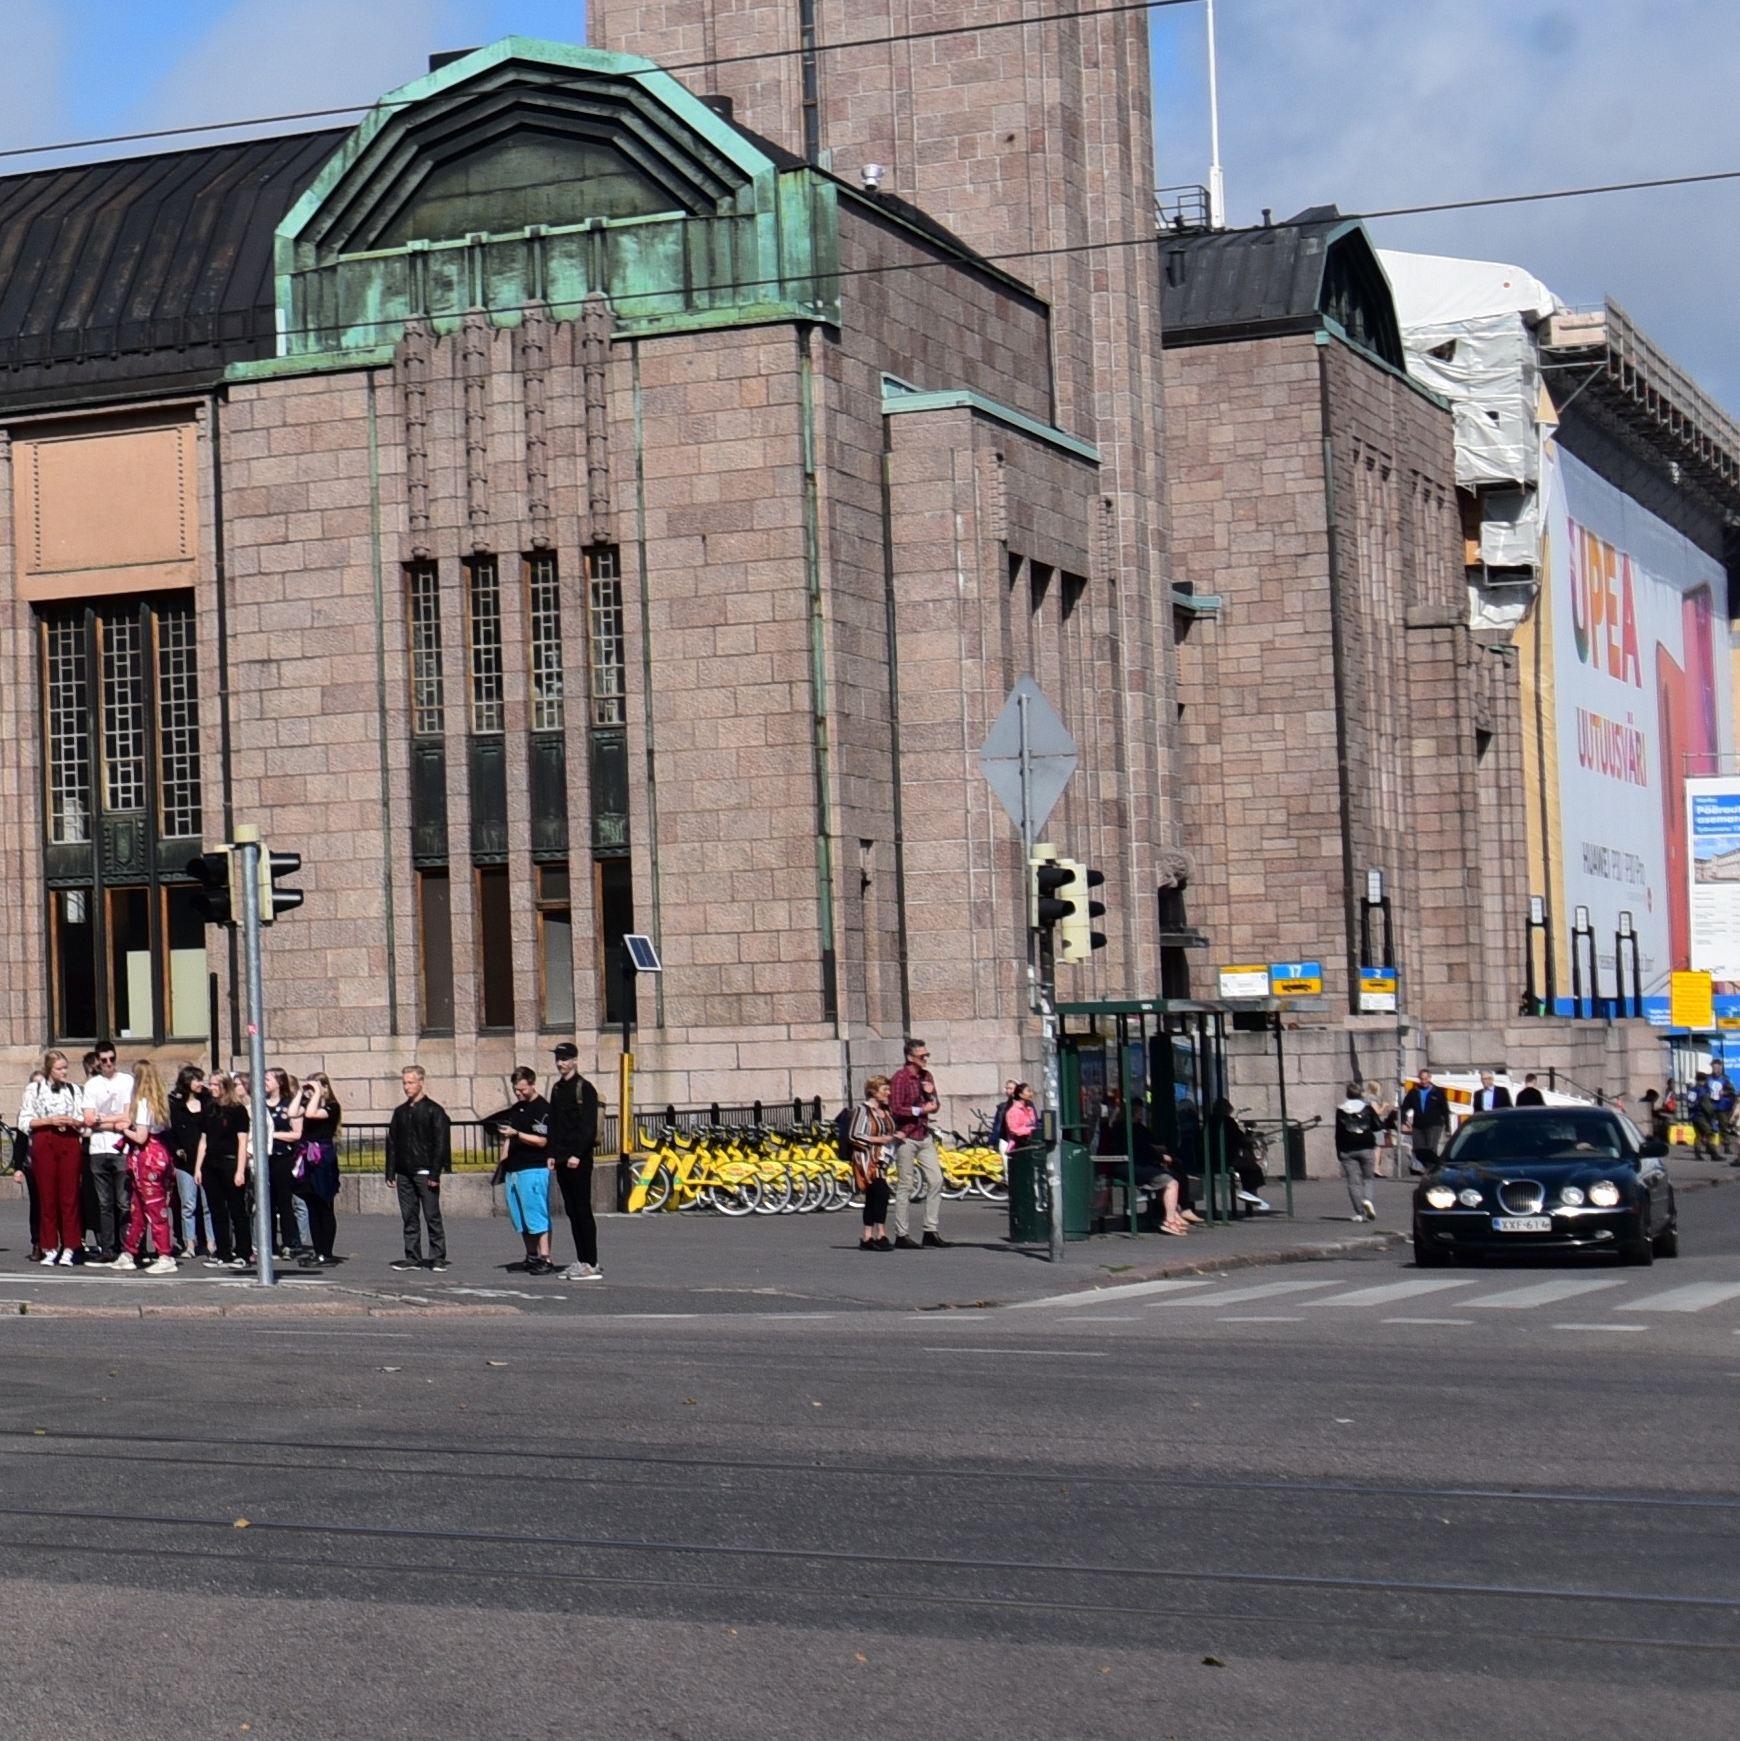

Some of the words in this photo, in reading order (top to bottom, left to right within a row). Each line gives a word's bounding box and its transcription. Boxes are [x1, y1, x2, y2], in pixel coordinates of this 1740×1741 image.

[1567, 516, 1642, 689] UPEA
[1575, 706, 1648, 788] UUTUUSVÄRI
[1288, 965, 1302, 979] 17
